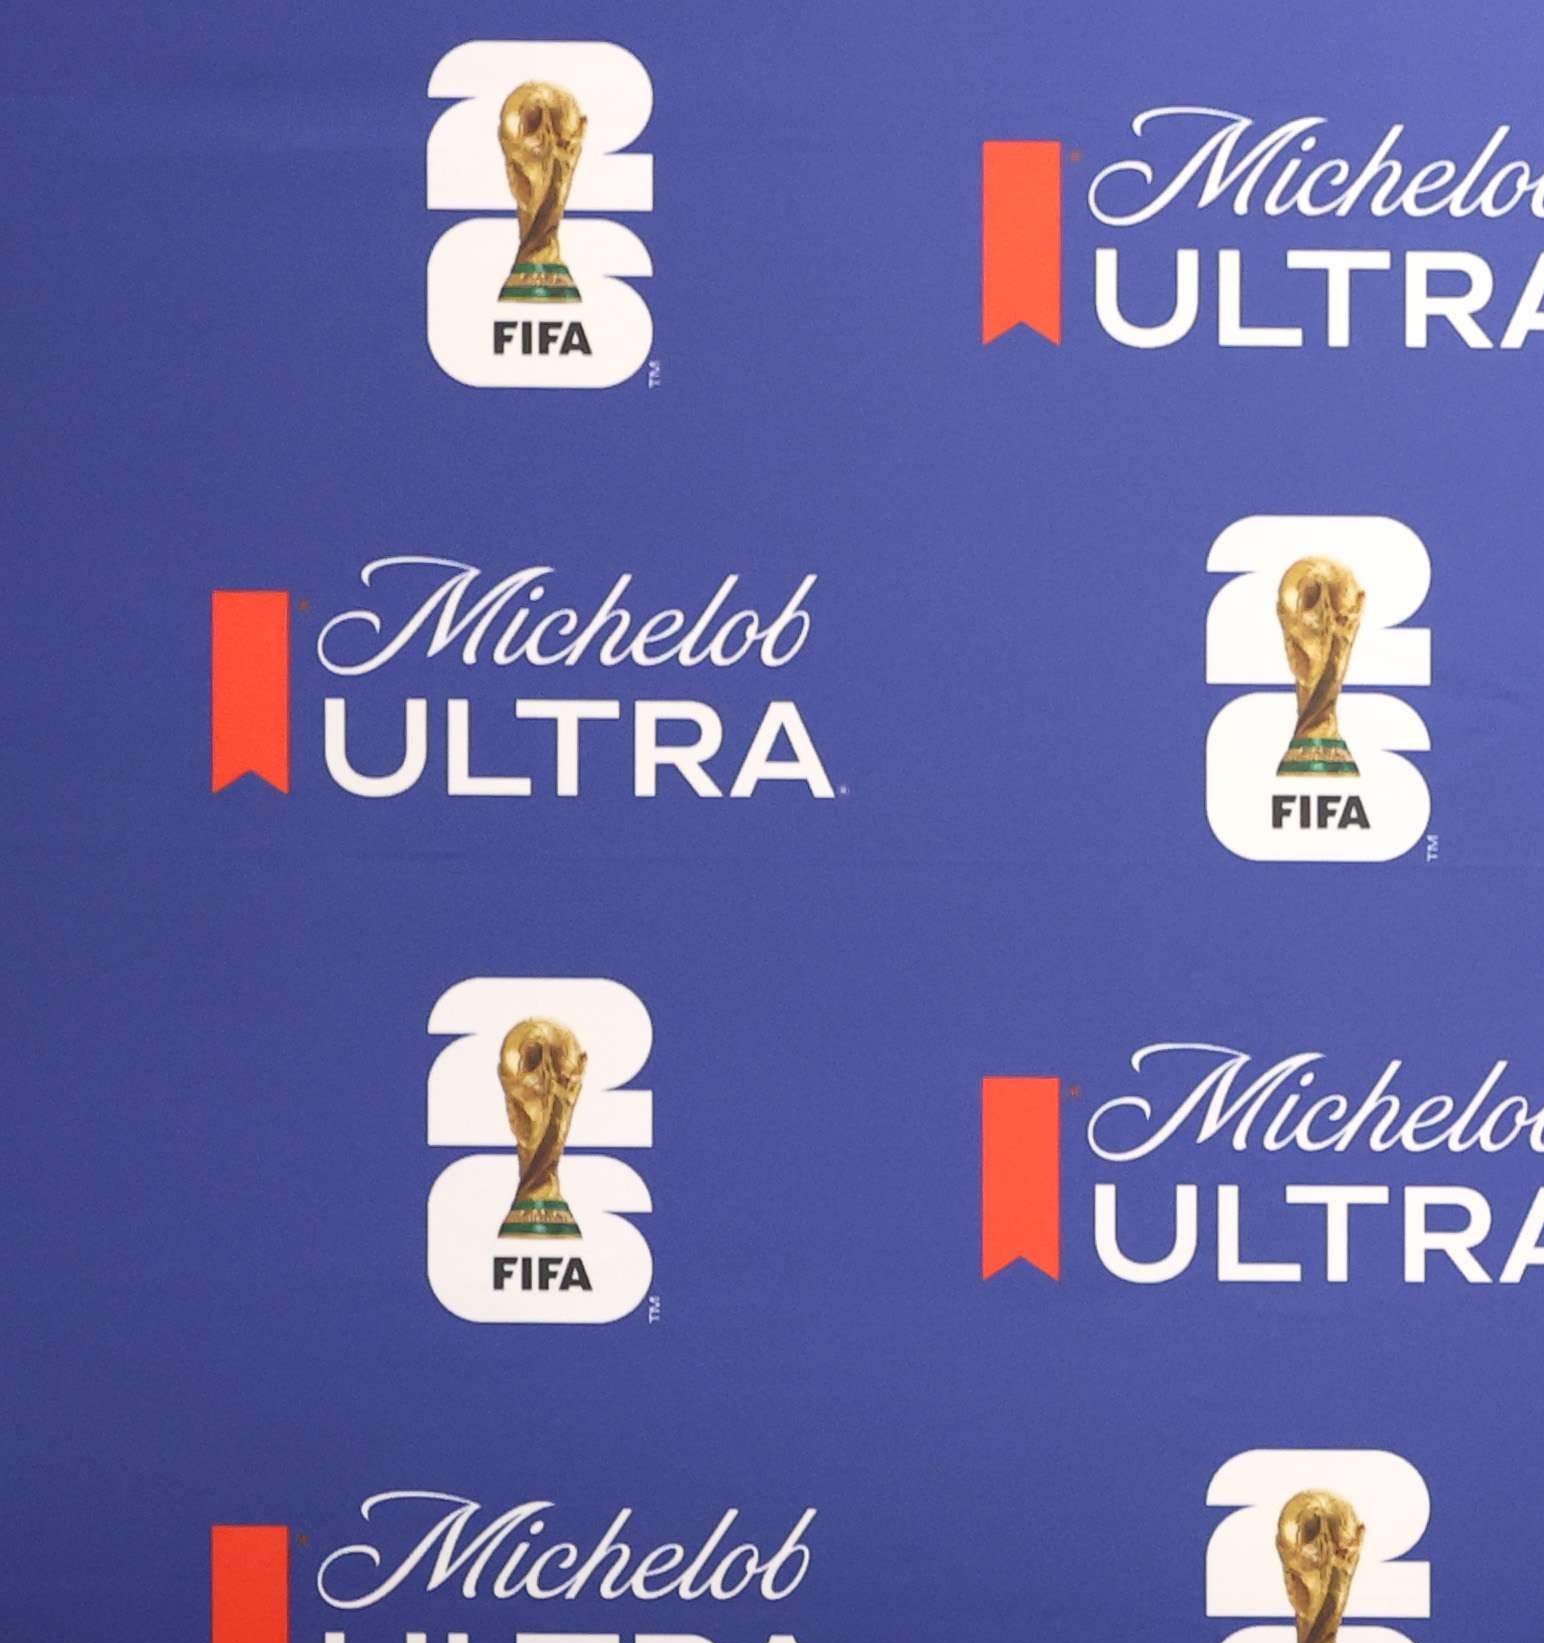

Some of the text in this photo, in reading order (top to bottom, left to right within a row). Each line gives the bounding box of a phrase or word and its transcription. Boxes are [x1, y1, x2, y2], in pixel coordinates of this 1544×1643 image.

[494, 321, 591, 355] FIFA
[318, 556, 816, 675] Michelob
[325, 698, 834, 798] ULTRA
[1272, 795, 1370, 829] FIFA
[494, 1257, 592, 1290] FIFA
[318, 1491, 816, 1609] Michelob
